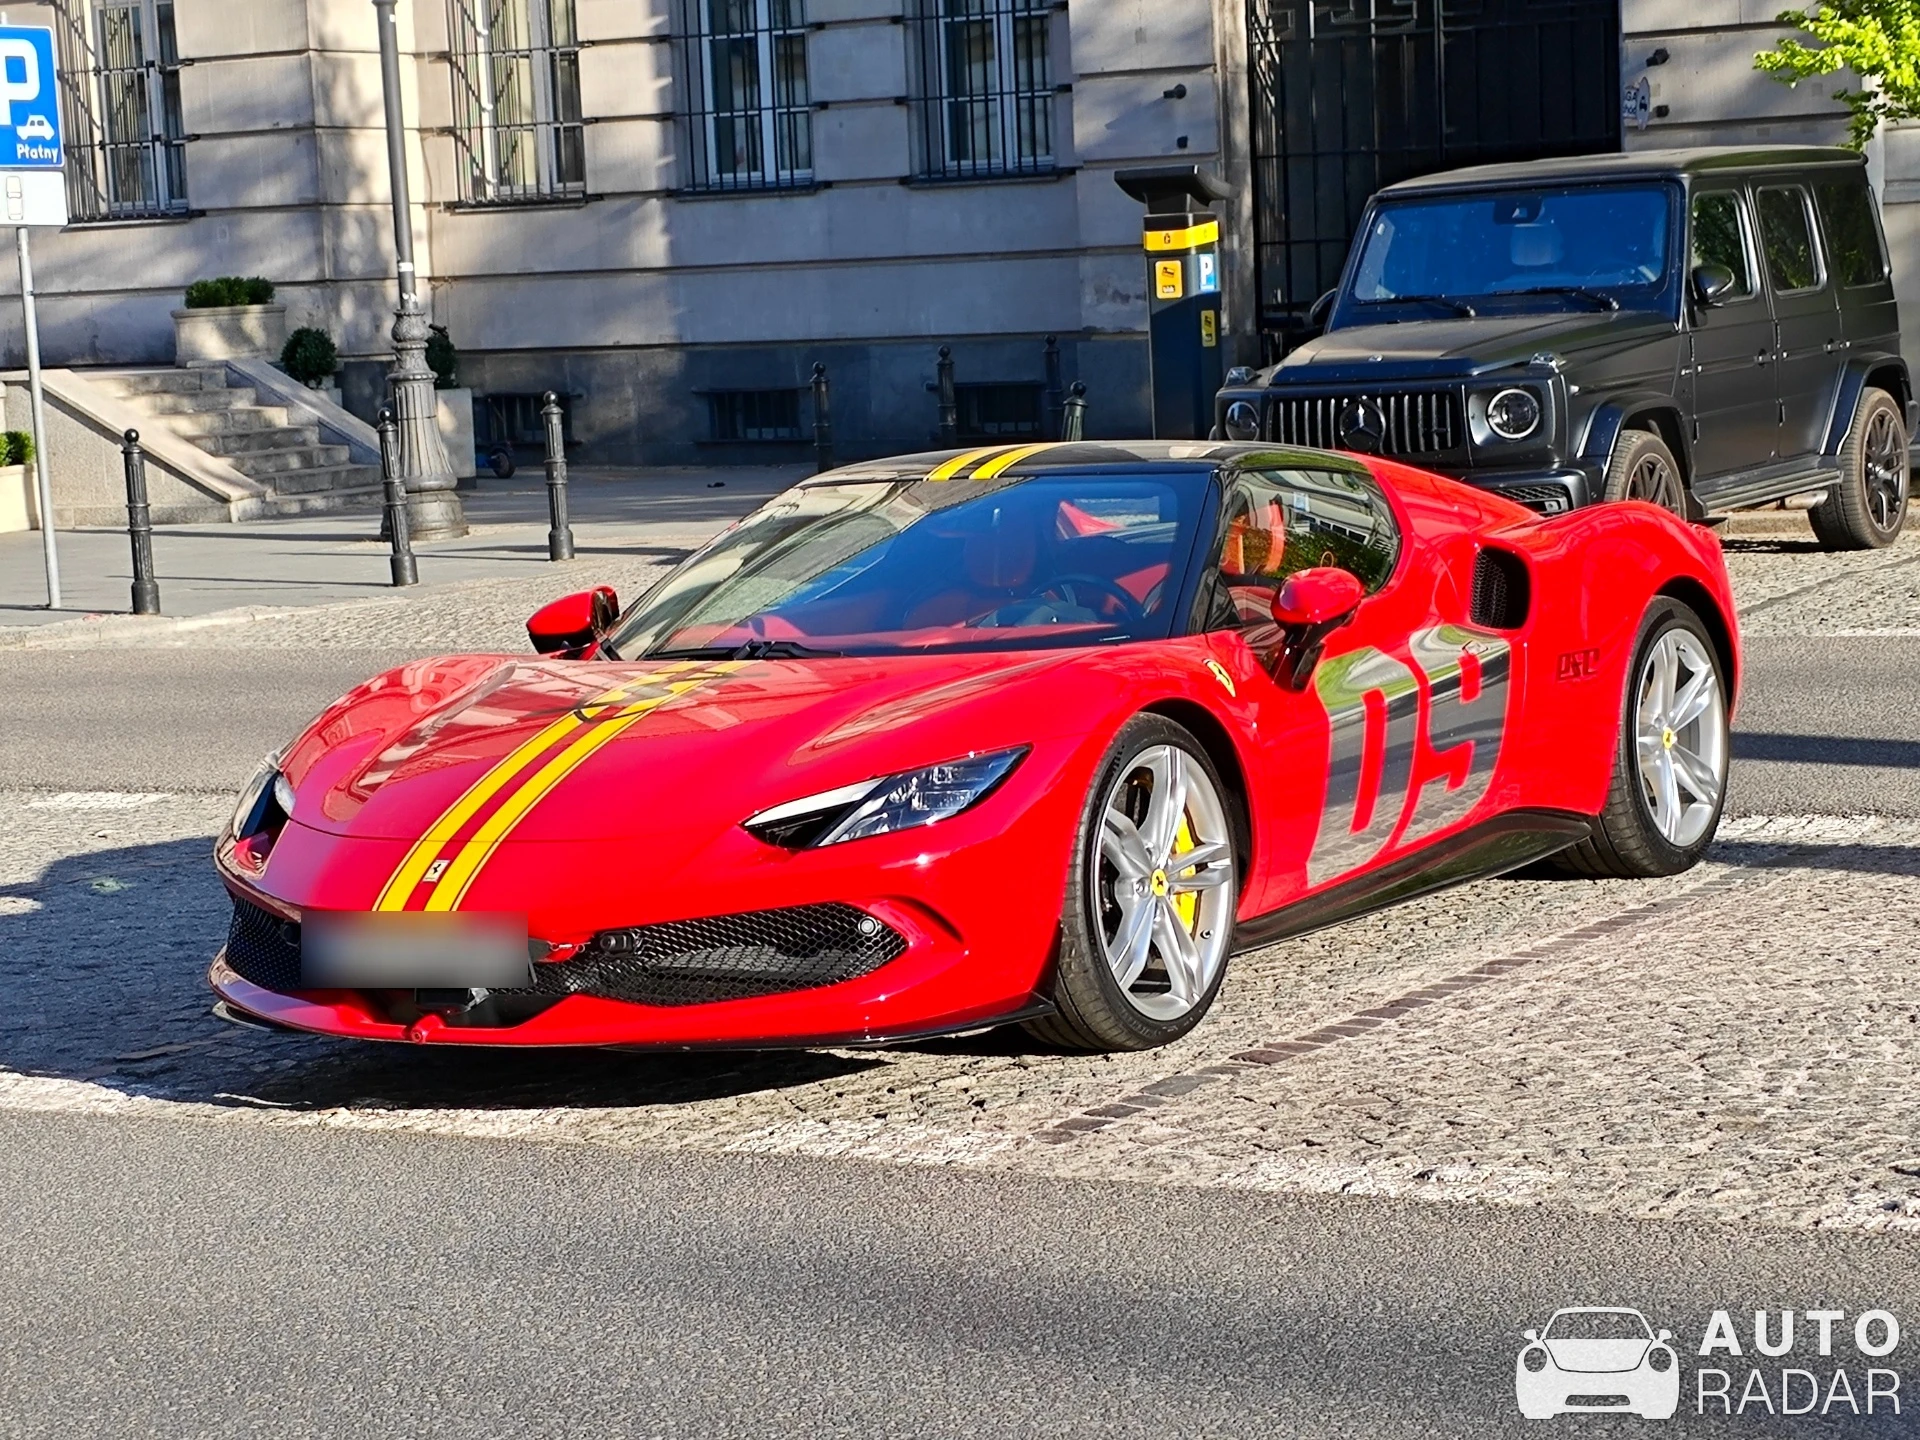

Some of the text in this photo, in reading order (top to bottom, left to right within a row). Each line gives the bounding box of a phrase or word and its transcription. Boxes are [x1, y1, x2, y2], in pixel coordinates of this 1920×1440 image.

[0, 38, 40, 125] P
[16, 143, 59, 164] Płatny
[1200, 256, 1214, 286] P
